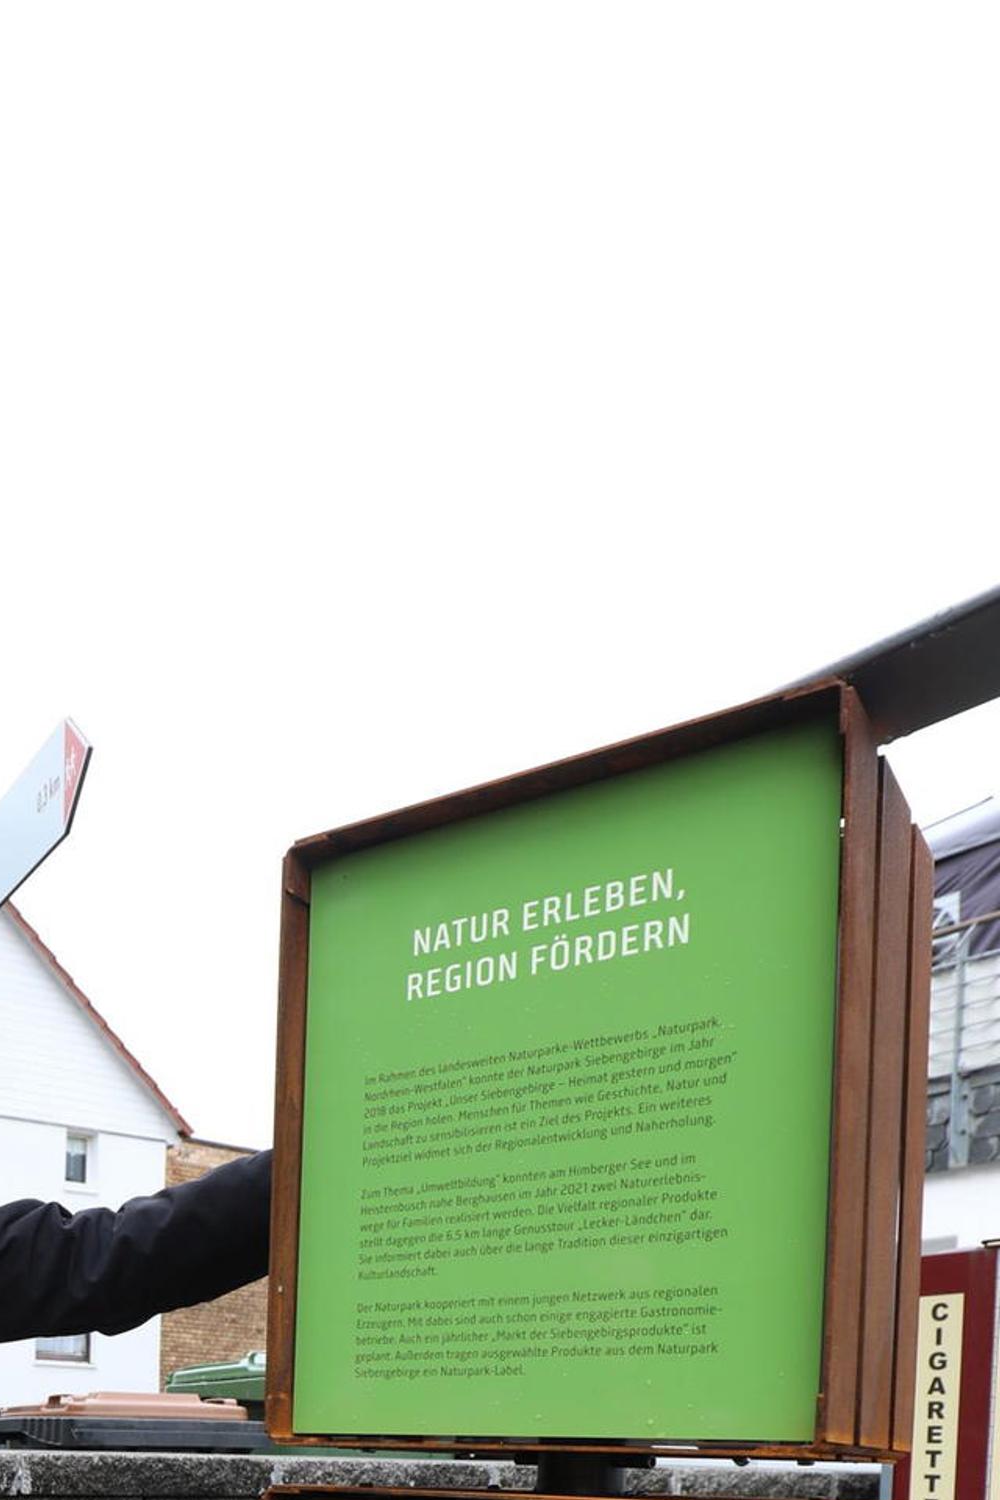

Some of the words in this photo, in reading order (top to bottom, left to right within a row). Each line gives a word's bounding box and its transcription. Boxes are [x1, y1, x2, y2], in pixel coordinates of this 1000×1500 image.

[413, 908, 509, 956] NATUR
[522, 868, 686, 932] ERLEBEN,
[407, 952, 518, 1001] REGION
[531, 913, 689, 975] FÖRDERN
[507, 1027, 649, 1064] Naturparke-Wettbewerbs
[525, 1056, 581, 1078] Naturpark
[584, 1043, 667, 1069] Siebengebirge
[669, 1040, 686, 1053] im
[687, 1035, 714, 1050] Jahr
[567, 1070, 608, 1087] Heimat
[610, 1063, 656, 1083] gestern
[657, 1059, 682, 1074] und
[529, 1094, 572, 1110] Themen
[573, 1090, 594, 1104] wie
[595, 1080, 665, 1102] Geschichte,
[665, 1075, 700, 1091] Natur
[702, 1071, 727, 1086] und
[519, 1116, 537, 1129] ein
[538, 1113, 559, 1127] Ziel
[560, 1110, 582, 1124] des
[583, 1103, 635, 1123] Projekts.
[637, 1100, 657, 1114] Ein
[658, 1092, 712, 1111] weiteres
[493, 1125, 608, 1152] Regionalentwicklung
[609, 1122, 633, 1135] und
[634, 1111, 717, 1135] Naherholung.
[501, 1168, 547, 1184] konnten
[548, 1169, 566, 1179] am
[567, 1159, 627, 1179] Himberger
[629, 1156, 652, 1170] See
[653, 1153, 678, 1167] und
[679, 1151, 696, 1164] im
[517, 1187, 532, 1199] im
[534, 1185, 557, 1198] Jahr
[559, 1182, 588, 1195] 2021
[590, 1178, 617, 1192] zwei
[619, 1169, 706, 1189] Naturerlebnis-
[536, 1203, 555, 1215] Die
[556, 1199, 596, 1213] Vielfalt
[598, 1193, 658, 1212] regionaler
[660, 1187, 718, 1204] Produkte
[512, 1219, 574, 1235] Genusstour
[688, 1207, 713, 1220] dar.
[523, 1238, 555, 1254] lange
[557, 1234, 607, 1249] Tradition
[608, 1231, 645, 1245] dieser
[646, 1225, 729, 1245] einzigartigen
[531, 1291, 570, 1306] jungen
[571, 1288, 626, 1302] Netzwerk
[628, 1289, 651, 1299] aus
[651, 1283, 718, 1300] regionalen
[505, 1311, 537, 1323] schon
[538, 1309, 573, 1324] einige
[574, 1306, 637, 1322] engagierte
[639, 1302, 723, 1317] Gastronomie-
[528, 1328, 547, 1339] der
[690, 1322, 707, 1334] ist
[480, 1346, 549, 1361] ausgewählte
[549, 1344, 602, 1356] Produkte
[604, 1346, 625, 1355] aus
[627, 1342, 655, 1354] dem
[656, 1340, 719, 1356] Naturpark
